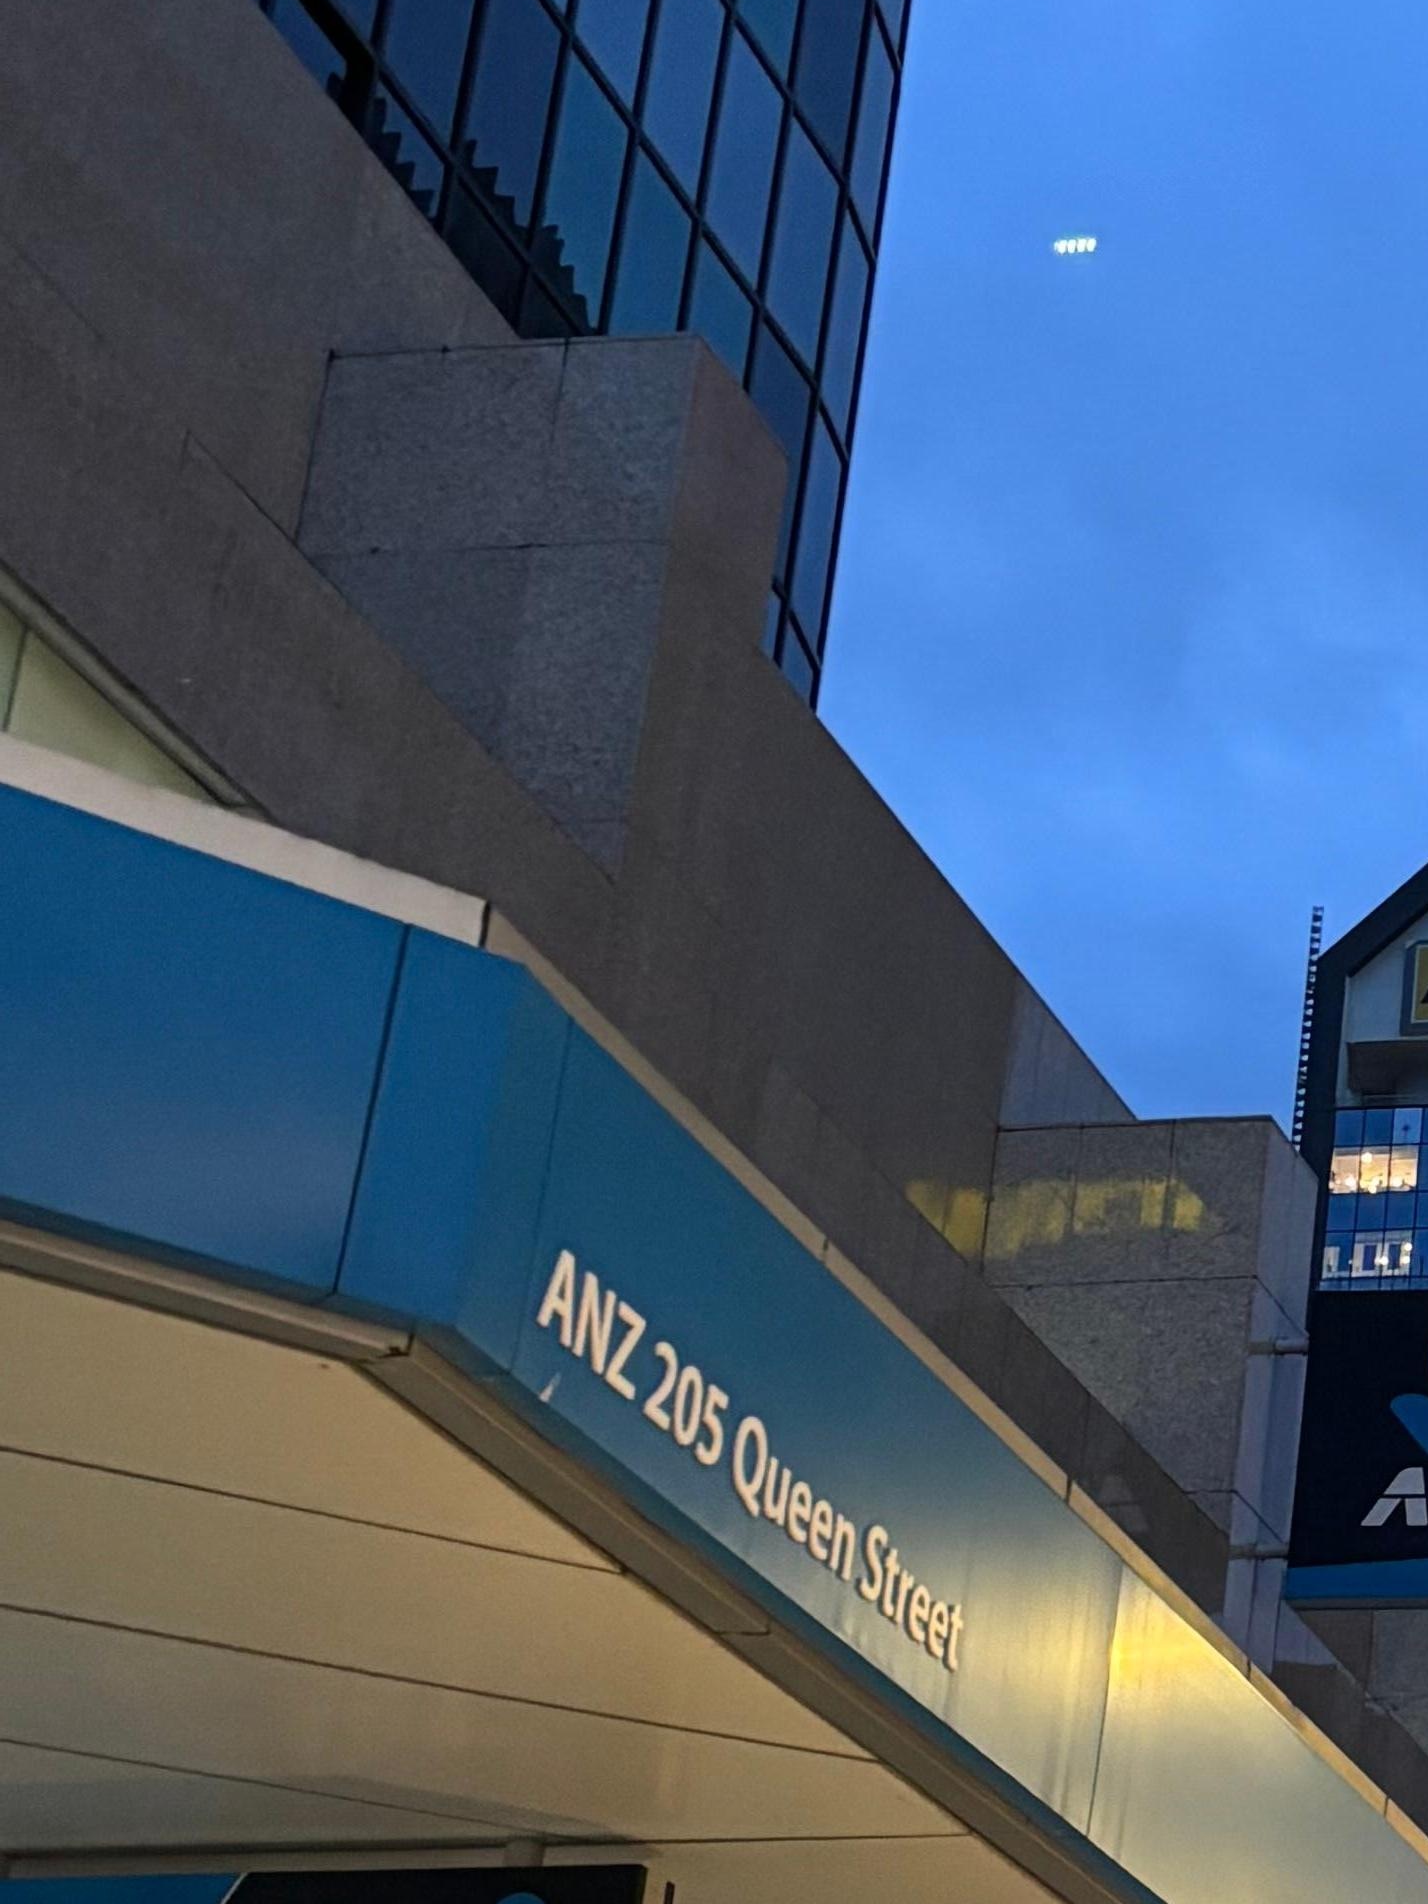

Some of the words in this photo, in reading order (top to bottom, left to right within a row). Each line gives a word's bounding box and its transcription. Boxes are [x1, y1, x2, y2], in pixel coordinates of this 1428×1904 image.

[536, 1249, 647, 1400] ANZ
[643, 1342, 729, 1465] 205
[733, 1416, 857, 1583] Queen
[860, 1526, 964, 1672] Street
